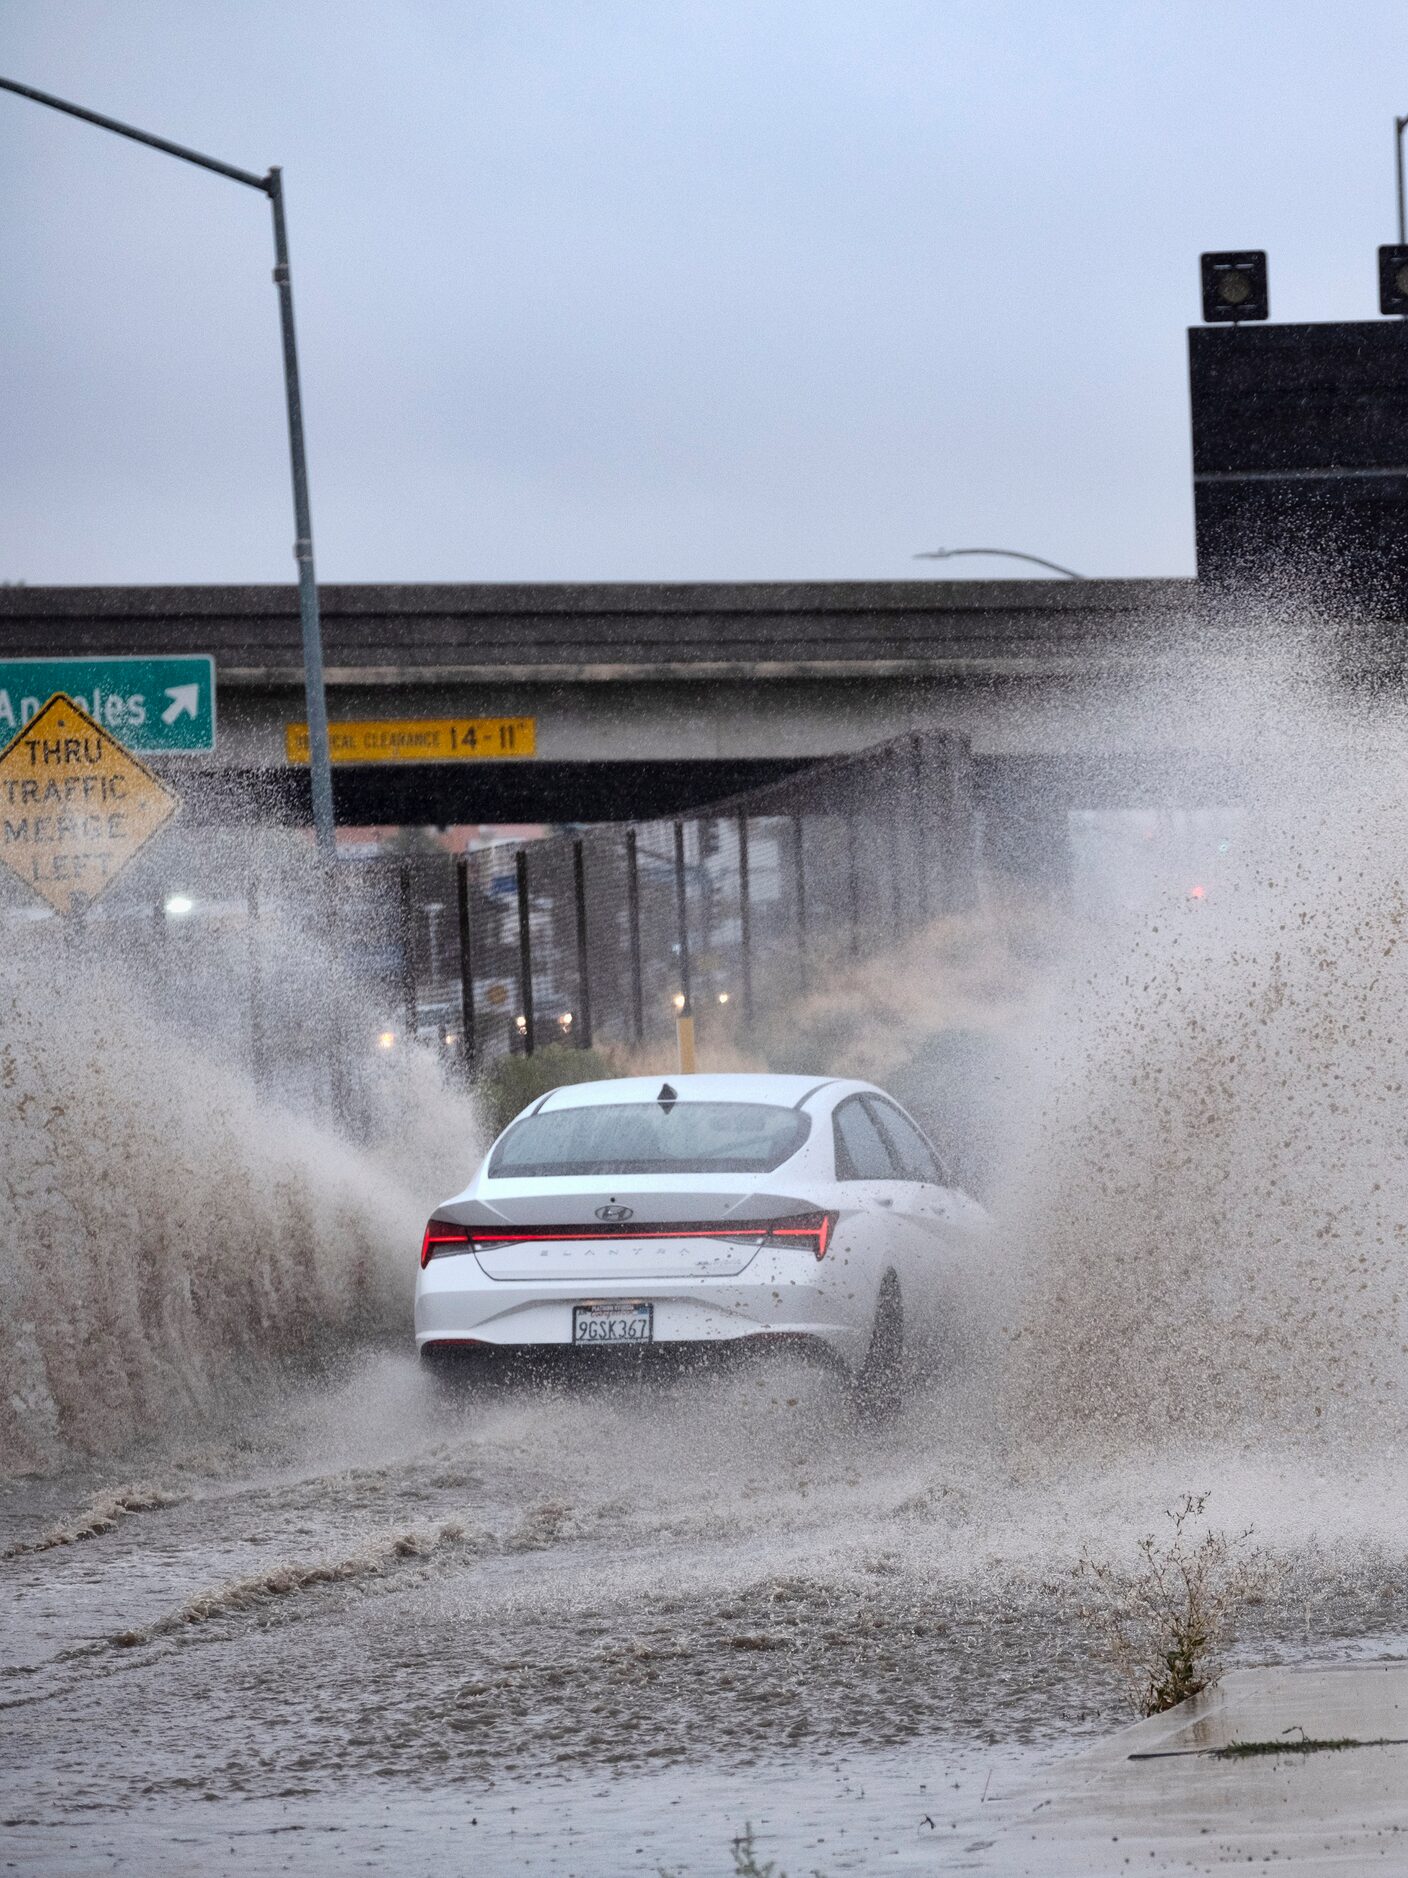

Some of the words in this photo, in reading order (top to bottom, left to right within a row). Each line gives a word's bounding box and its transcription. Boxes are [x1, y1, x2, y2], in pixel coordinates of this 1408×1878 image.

[25, 737, 101, 766] THRU
[363, 731, 441, 749] CLEARANCE
[3, 774, 129, 805] TRAFFIC
[3, 812, 127, 844] MERGE
[32, 852, 110, 882] LEFT
[579, 1319, 647, 1339] 9GSK367
